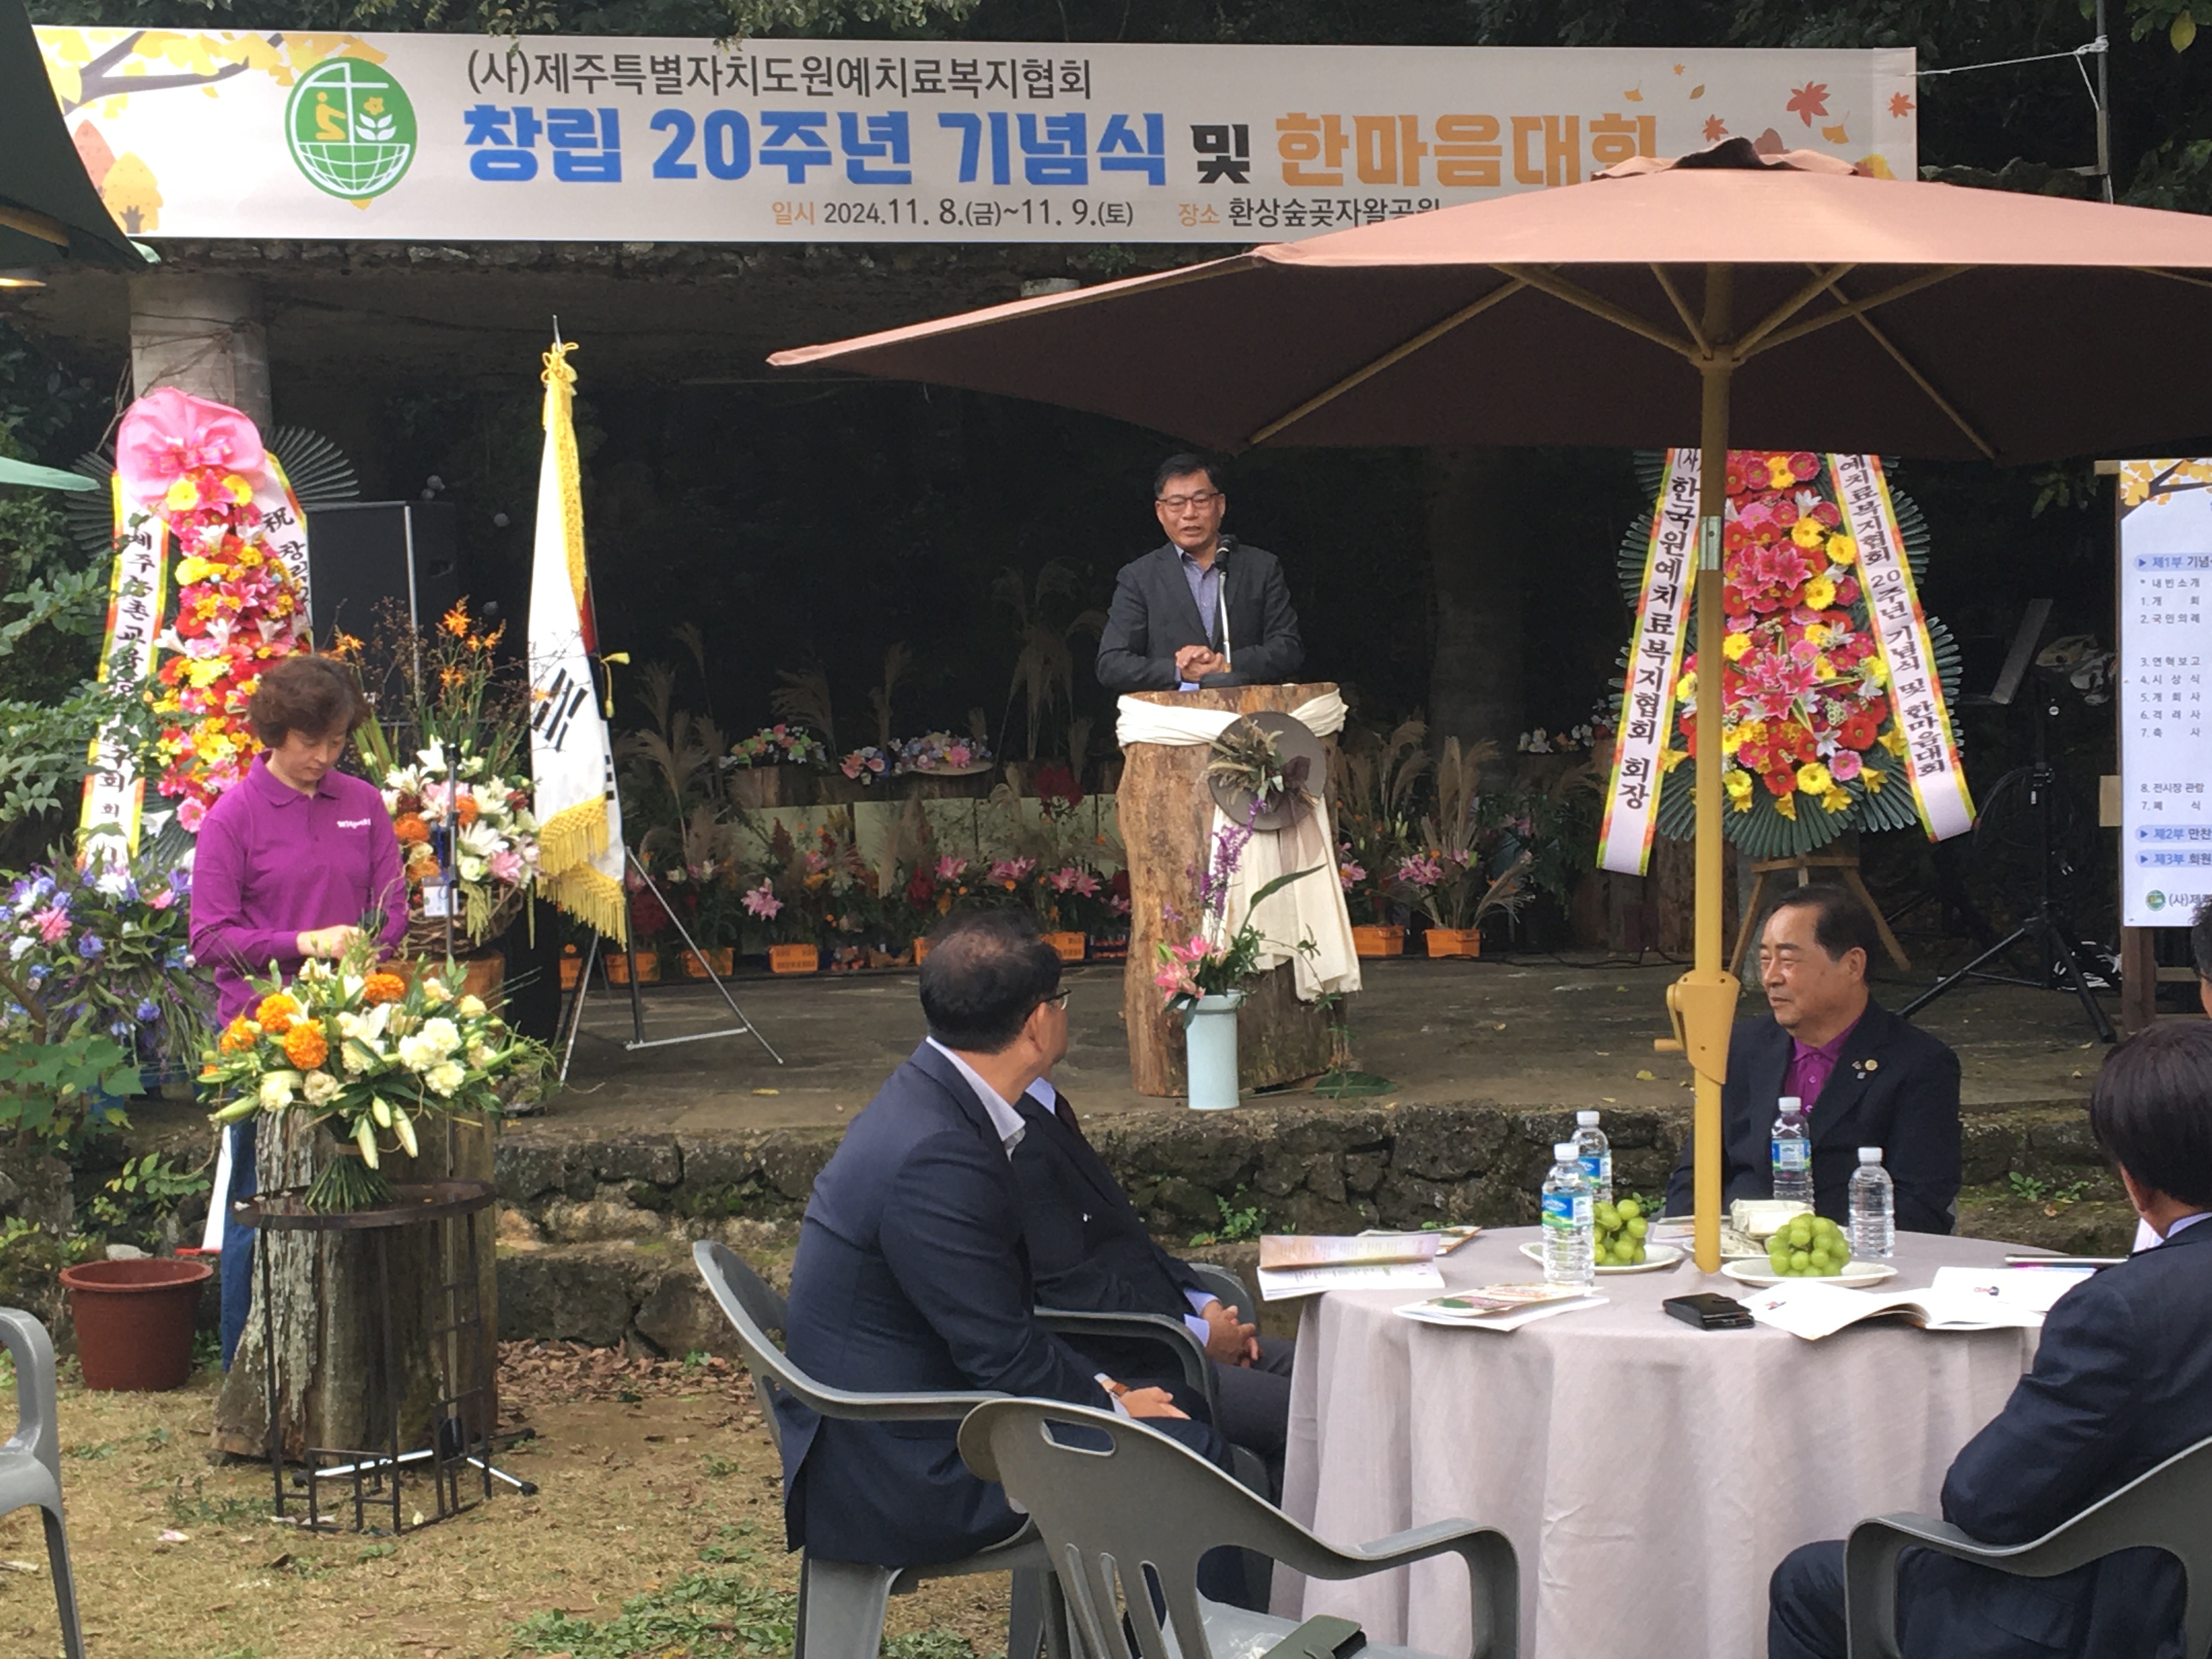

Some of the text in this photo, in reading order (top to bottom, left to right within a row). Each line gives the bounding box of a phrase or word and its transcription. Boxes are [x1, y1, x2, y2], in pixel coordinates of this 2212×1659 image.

[469, 48, 1090, 99] (사)제주특별자치도원예치료복지협회
[464, 105, 621, 182] 창립
[651, 109, 912, 184] 20주년
[938, 112, 1165, 185] 기념식
[1190, 125, 1250, 184] 및
[772, 202, 814, 225] 일시
[1179, 204, 1220, 226] 장소
[2187, 556, 2212, 568] 기념
[1886, 625, 1921, 672] 기념식
[1898, 678, 1925, 698] 및
[1905, 701, 1945, 777] 한마음대회
